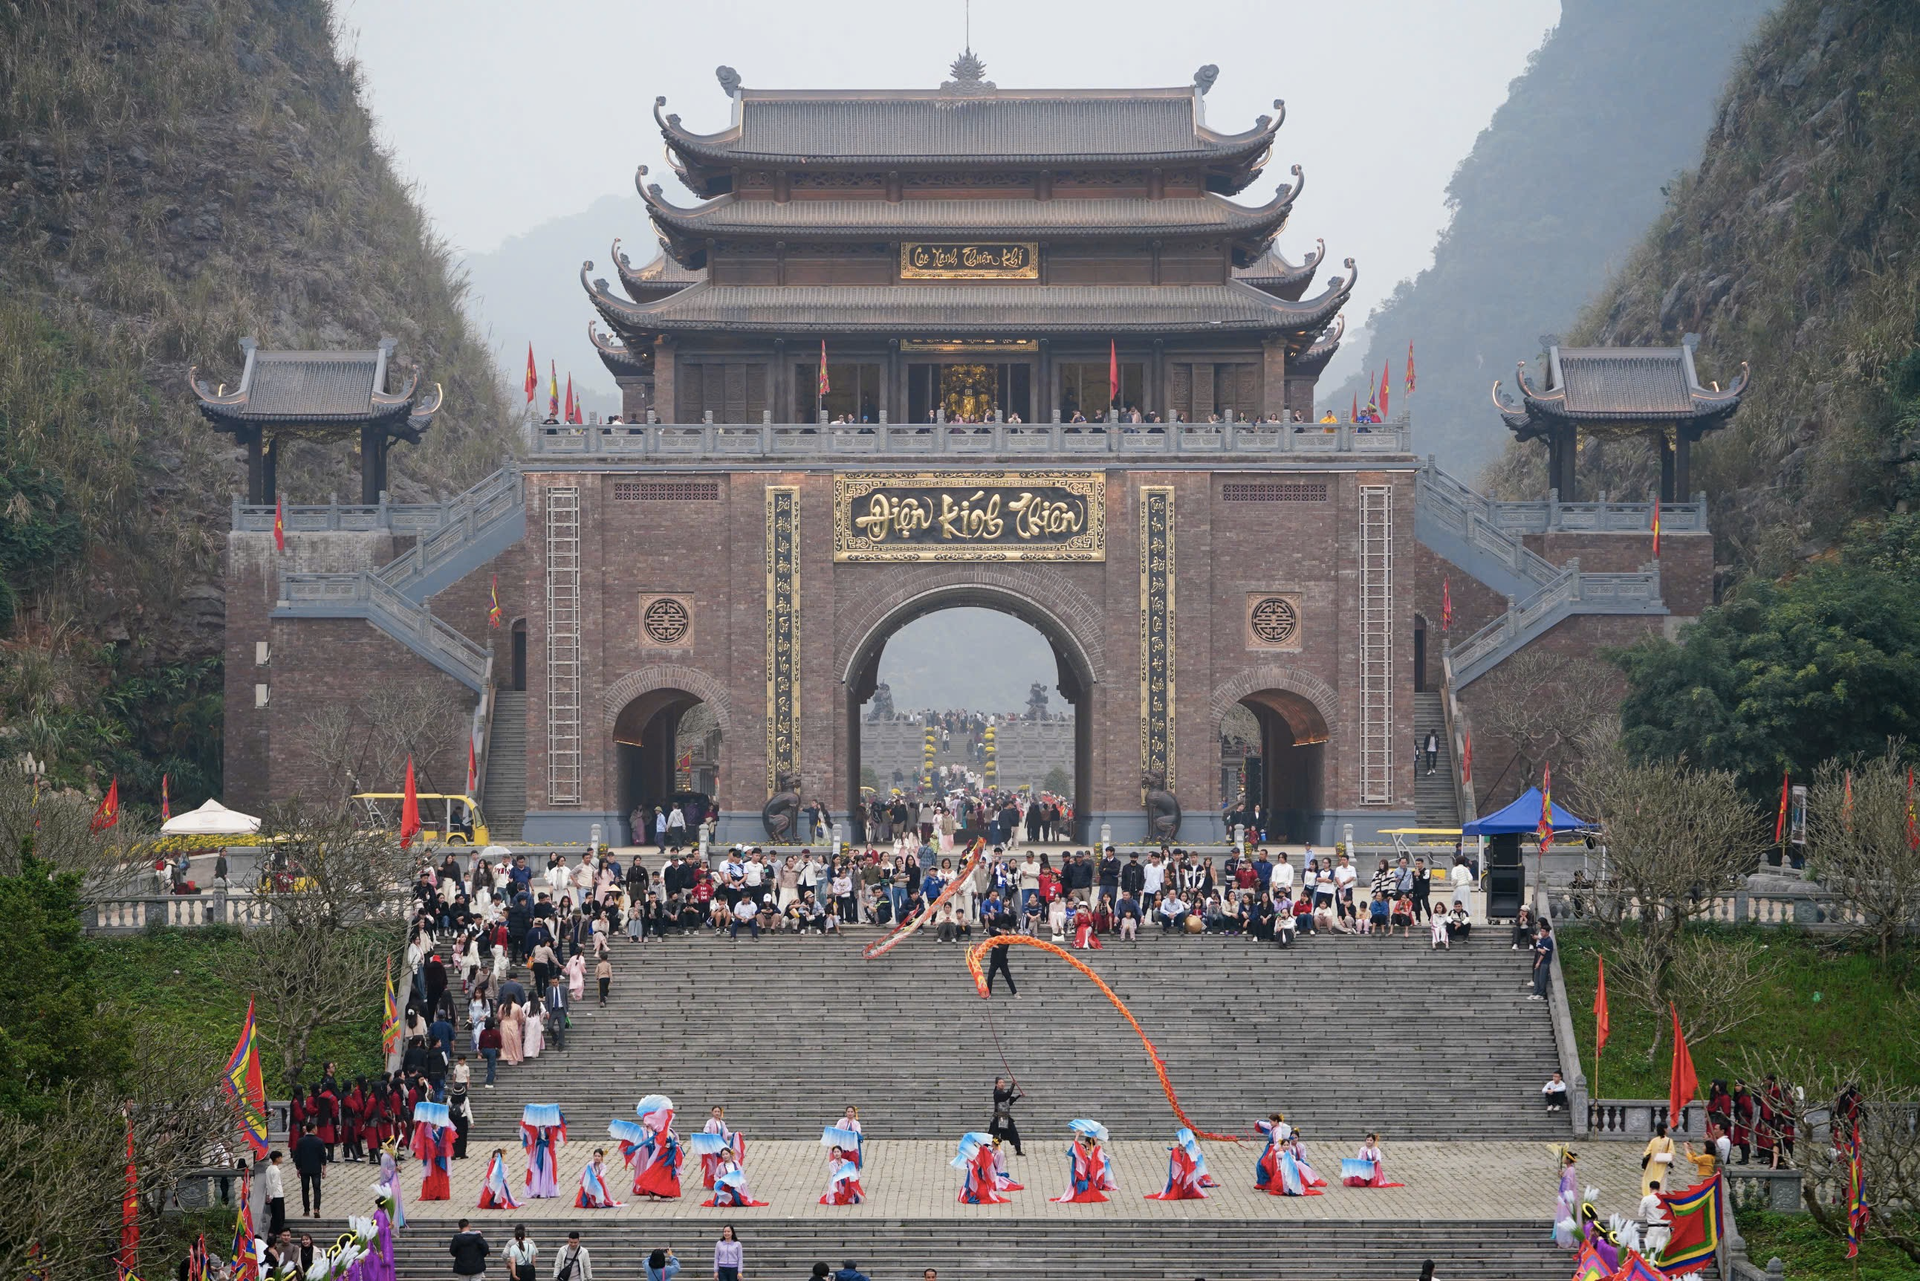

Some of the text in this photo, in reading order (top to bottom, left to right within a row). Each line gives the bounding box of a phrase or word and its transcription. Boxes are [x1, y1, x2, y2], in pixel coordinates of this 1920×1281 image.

[914, 246, 1024, 268] Cao Xanh Thuận Khí
[776, 496, 790, 512] Bái
[855, 490, 1084, 542] Điện Kính Thiên
[777, 577, 791, 594] Kính
